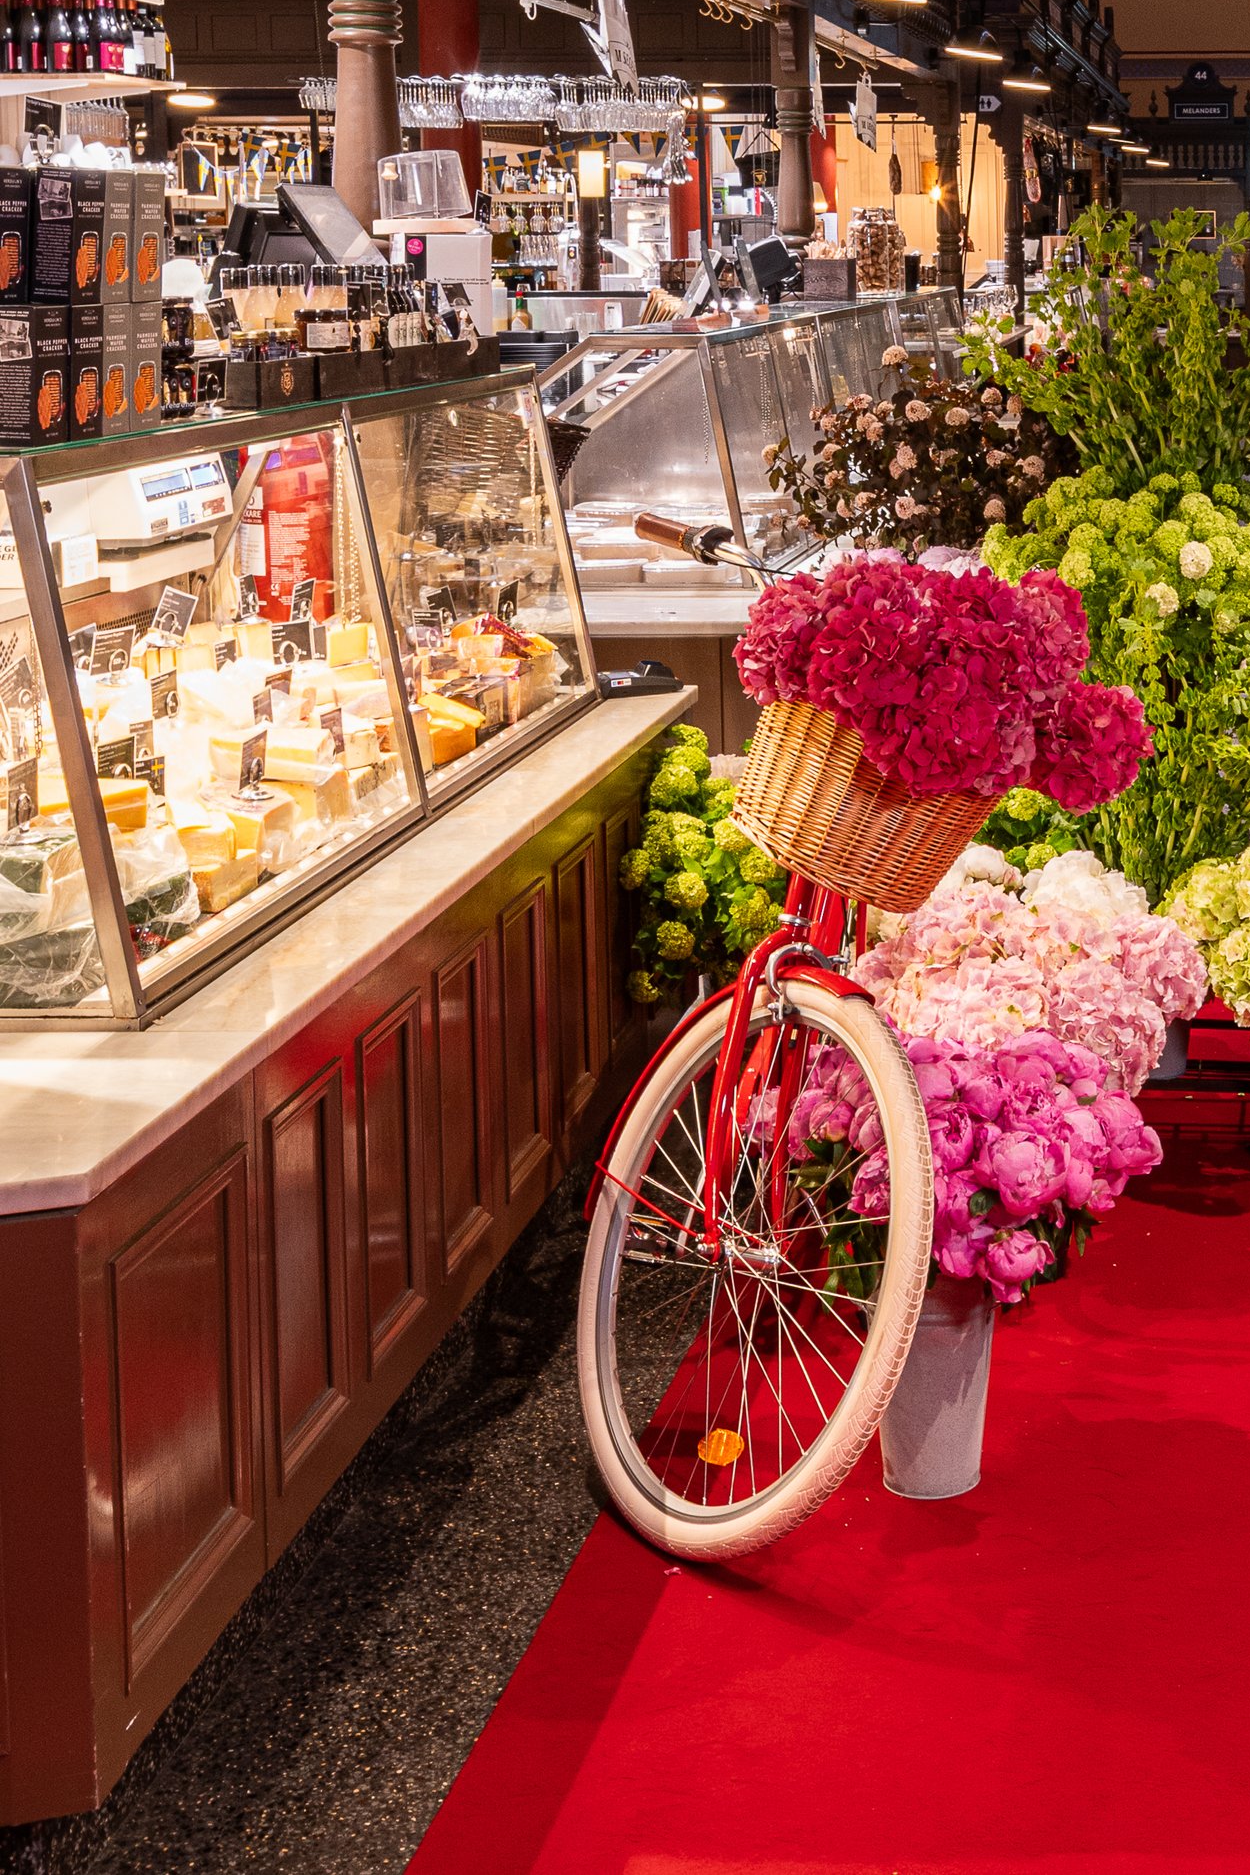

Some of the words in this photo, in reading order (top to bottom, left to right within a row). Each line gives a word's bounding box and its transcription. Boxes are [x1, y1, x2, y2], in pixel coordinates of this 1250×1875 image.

[615, 49, 621, 63] M
[1194, 71, 1207, 80] 44
[1182, 107, 1221, 115] MELANDERS
[82, 206, 101, 214] CRACKER
[37, 339, 52, 347] BLACK
[53, 338, 68, 346] PEPPER
